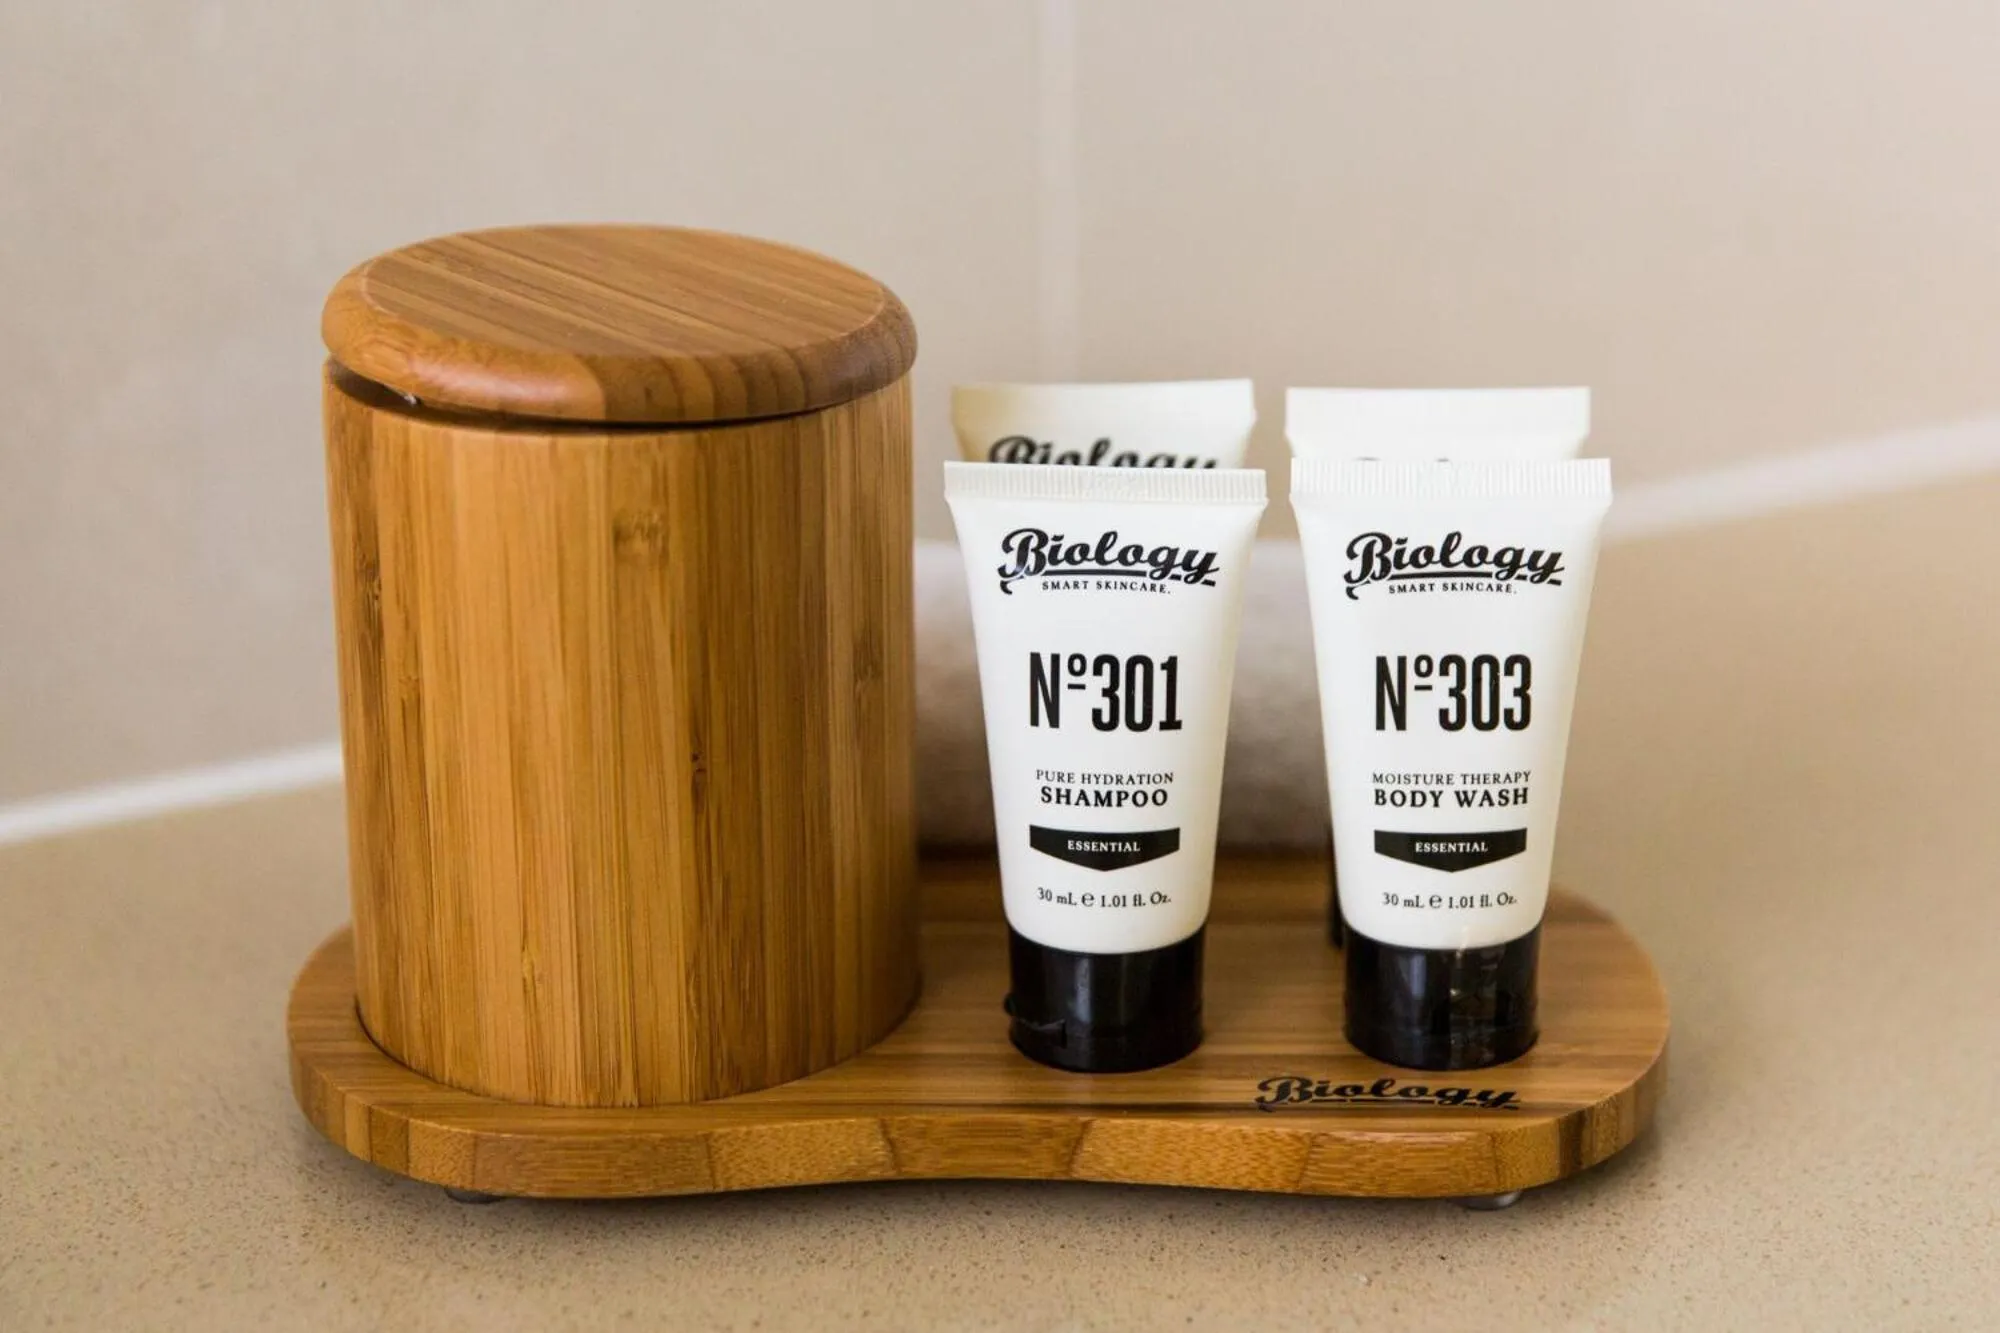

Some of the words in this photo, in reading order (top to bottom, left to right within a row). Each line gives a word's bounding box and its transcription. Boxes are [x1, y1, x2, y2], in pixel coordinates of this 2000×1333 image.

[997, 528, 1219, 594] Biology
[1344, 531, 1565, 600] Biology
[1042, 580, 1089, 592] SMART
[1389, 582, 1435, 594] SMART
[1036, 769, 1075, 784] PURE
[1081, 772, 1174, 785] HYDRATION
[1372, 773, 1455, 785] MOISTURE
[1460, 771, 1531, 785] THERAPY
[1040, 786, 1168, 807] SHAMPOO
[1374, 788, 1444, 808] BODY
[1454, 787, 1529, 808] WASH
[1067, 840, 1141, 852] ESSENTIAL
[1415, 841, 1489, 853] ESSENTIAL
[1038, 887, 1053, 902] 30
[1101, 895, 1127, 908] 1.01
[1150, 891, 1172, 905] Oz.
[1383, 892, 1399, 906] 30
[1448, 895, 1474, 909] 1.01
[1496, 892, 1518, 906] Oz.
[1255, 1076, 1521, 1111] Biology
